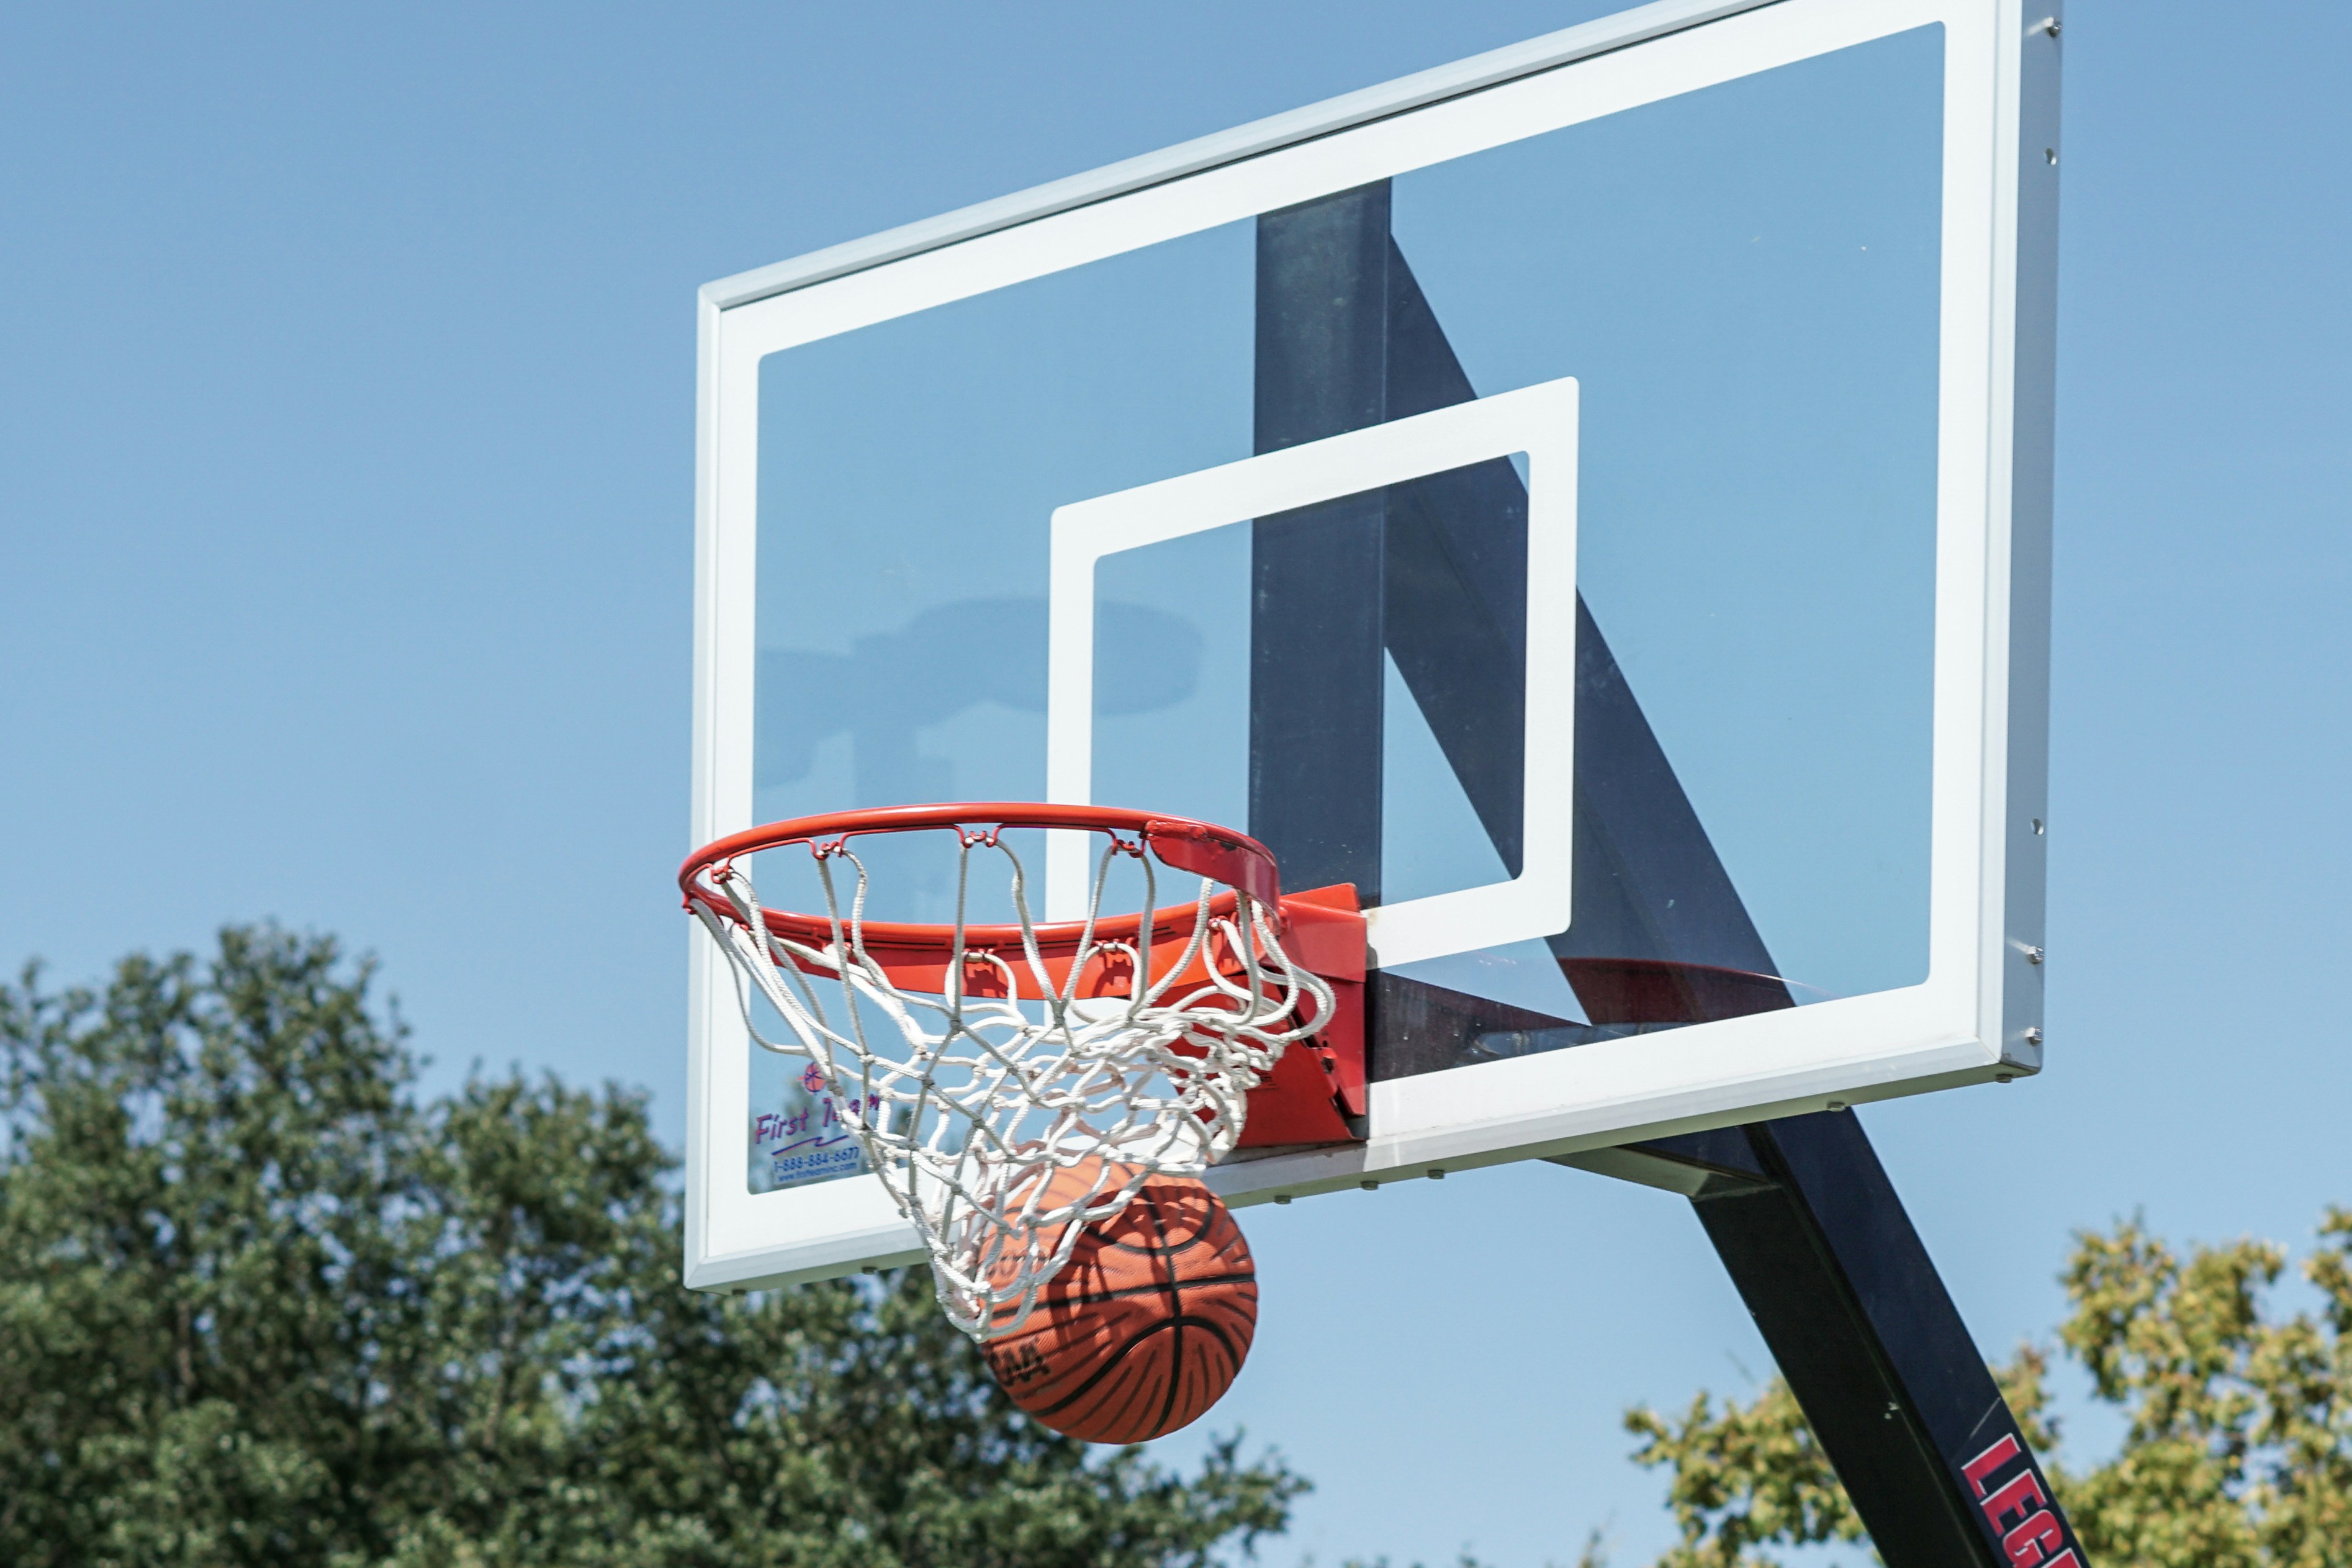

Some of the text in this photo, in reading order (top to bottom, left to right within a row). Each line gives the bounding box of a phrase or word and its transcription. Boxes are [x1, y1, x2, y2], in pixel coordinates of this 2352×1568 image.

[755, 1107, 809, 1144] First
[774, 1147, 860, 1173] 1-888-884-6677
[1960, 1432, 2082, 1568] LEG
